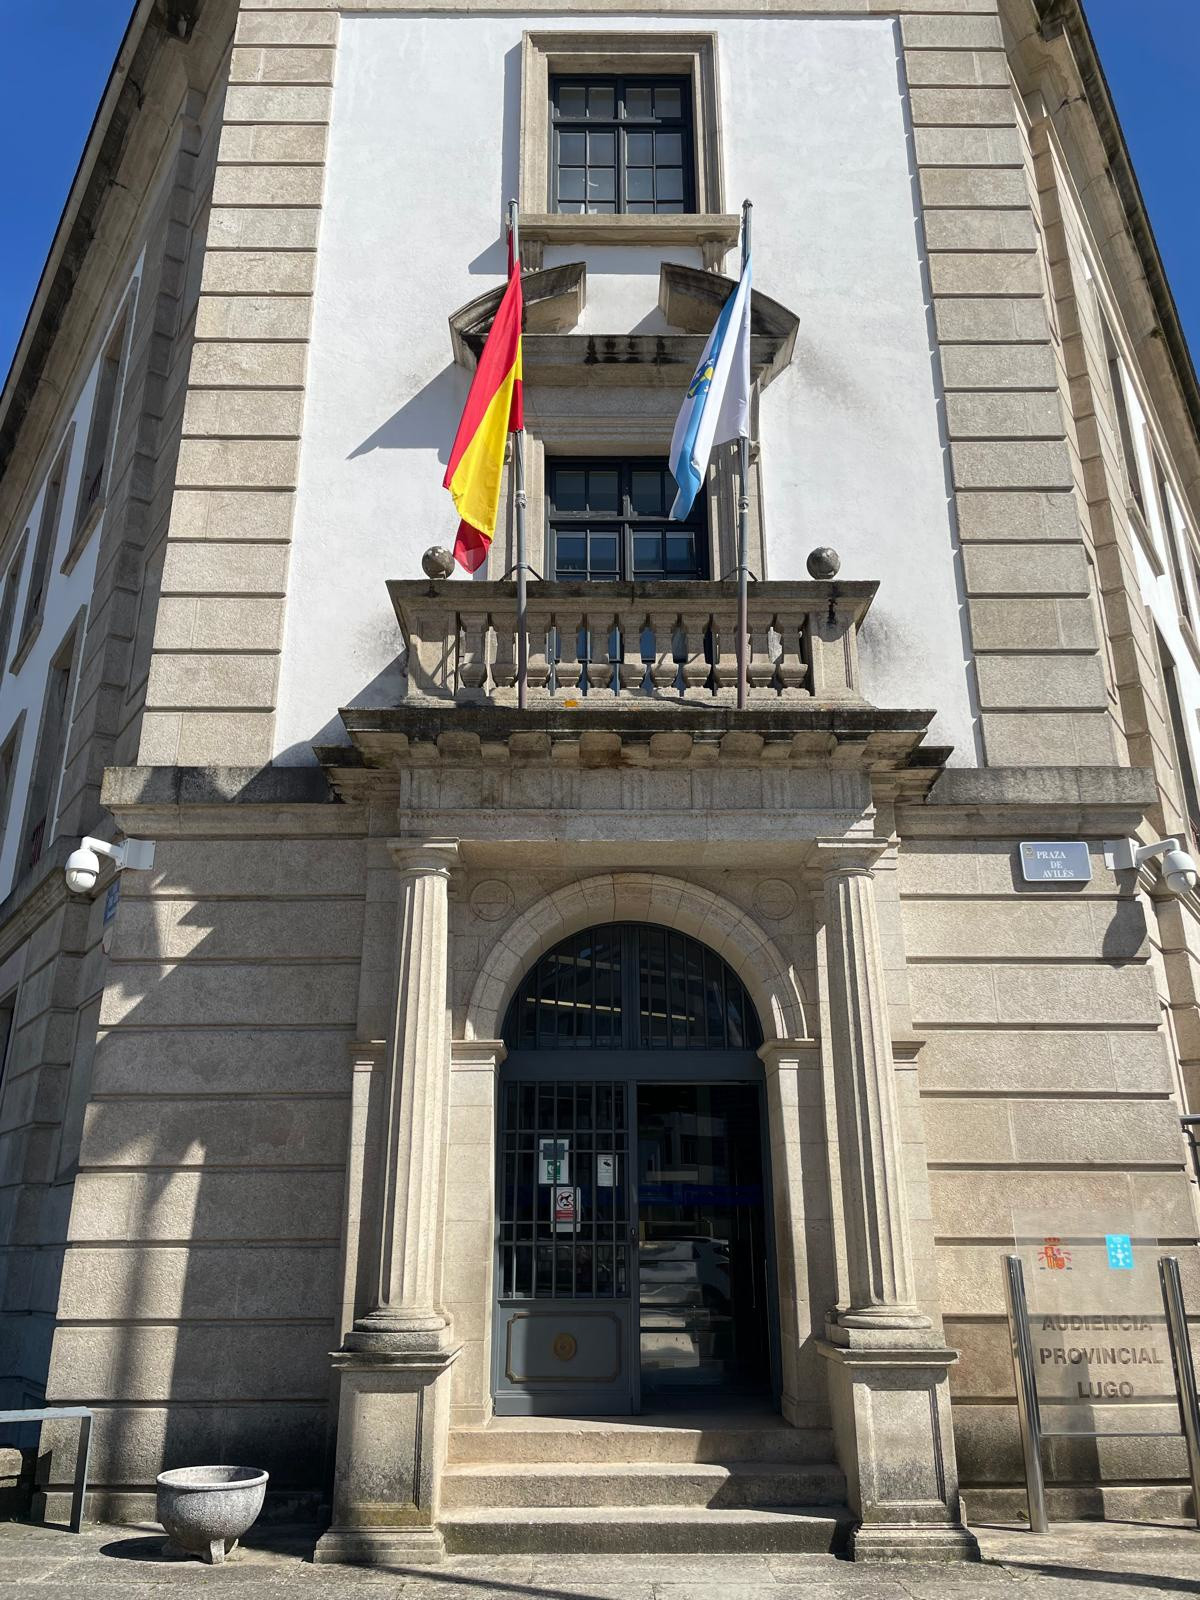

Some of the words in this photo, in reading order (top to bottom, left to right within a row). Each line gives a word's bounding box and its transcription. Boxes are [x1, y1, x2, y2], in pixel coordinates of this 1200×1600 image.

[1036, 850, 1067, 859] PRAZA
[1050, 860, 1063, 869] DE
[1042, 1314, 1153, 1331] AUDIENCIA
[1039, 1347, 1164, 1365] PROVINCIAL
[1077, 1381, 1134, 1398] LUGO
